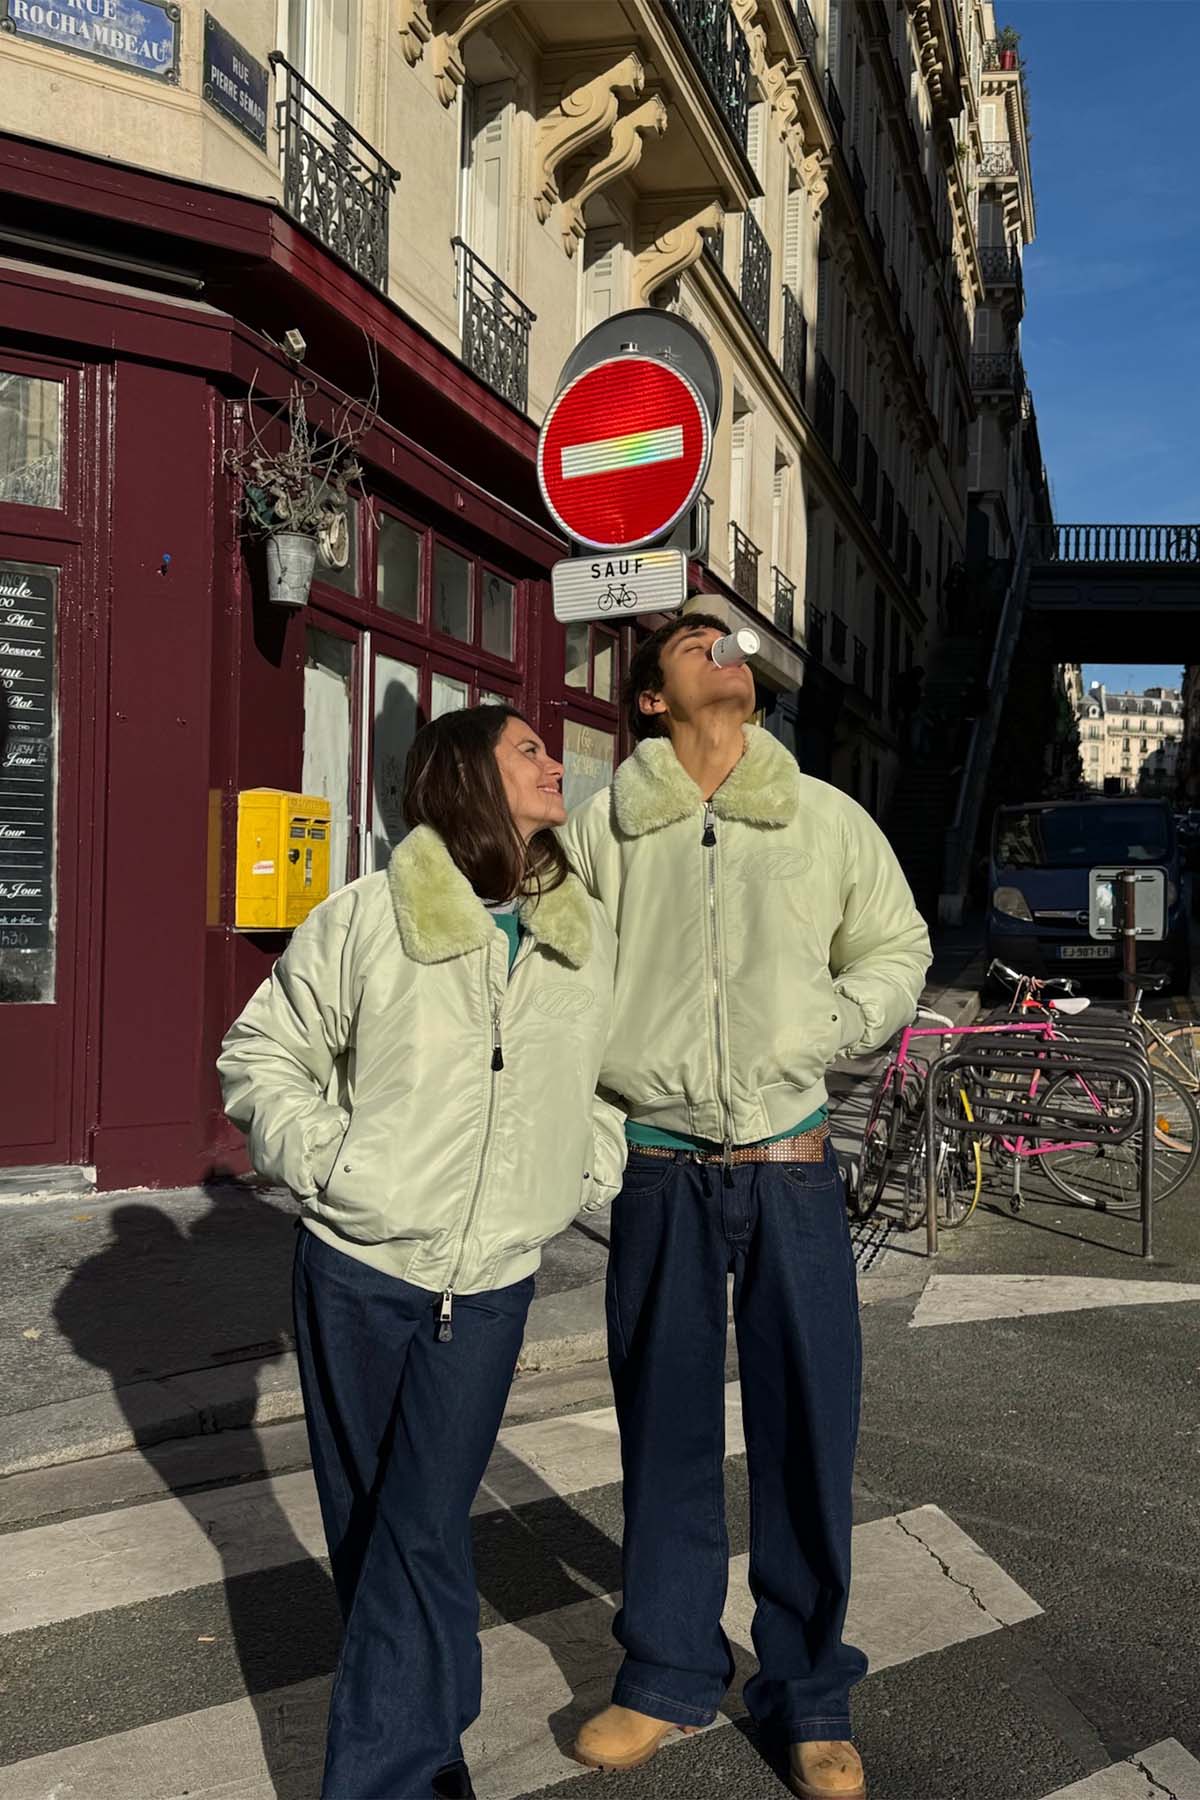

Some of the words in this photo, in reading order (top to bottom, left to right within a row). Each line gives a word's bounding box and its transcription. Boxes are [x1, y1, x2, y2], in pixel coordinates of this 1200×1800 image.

[67, 0, 118, 20] RUE
[14, 0, 167, 62] ROCHAMBEAU
[232, 56, 250, 86] RUE
[211, 64, 238, 102] PIERRE
[591, 558, 643, 578] SAUF
[5, 613, 34, 627] Plat
[0, 641, 41, 657] Dessert
[7, 694, 34, 709] Plat
[3, 751, 37, 768] Jour
[7, 883, 41, 899] Jour
